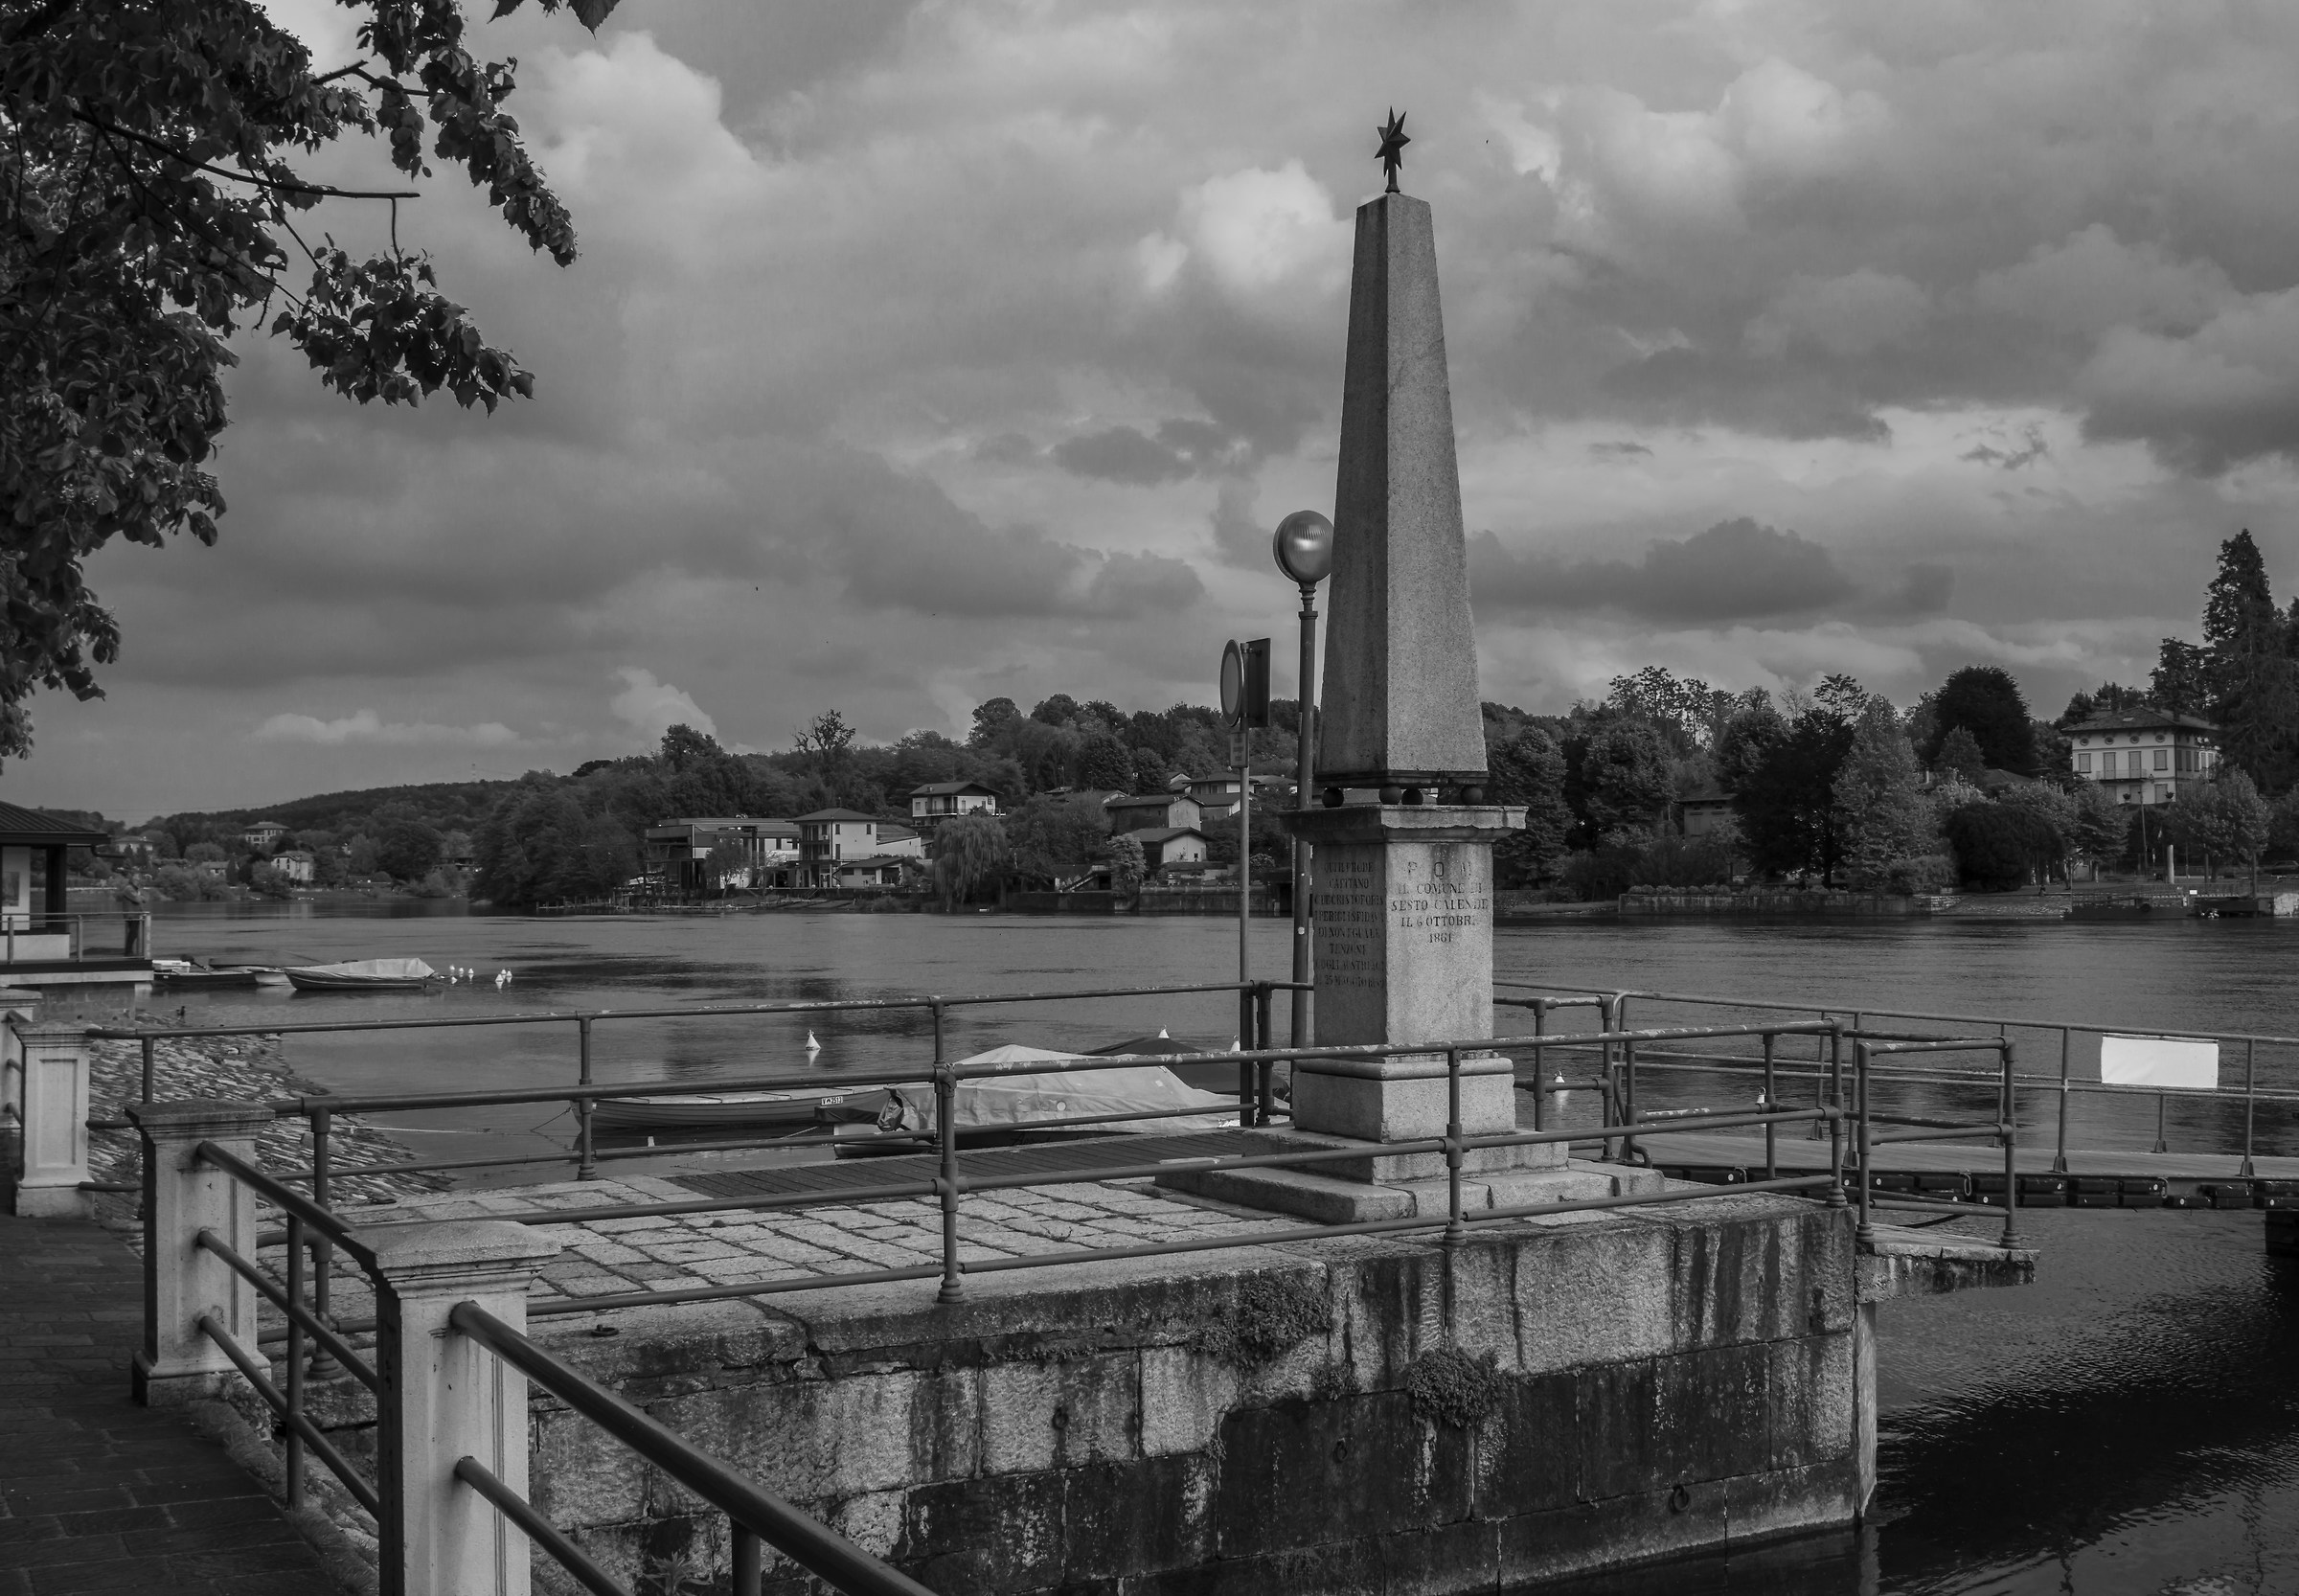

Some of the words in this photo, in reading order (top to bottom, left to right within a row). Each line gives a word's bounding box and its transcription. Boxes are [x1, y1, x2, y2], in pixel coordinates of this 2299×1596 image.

[1434, 861, 1445, 880] Q
[1417, 882, 1465, 895] COMUNE
[1391, 900, 1428, 912] SESTO
[1401, 917, 1413, 927] IL
[1417, 918, 1423, 927] 6
[1429, 933, 1452, 944] 1861
